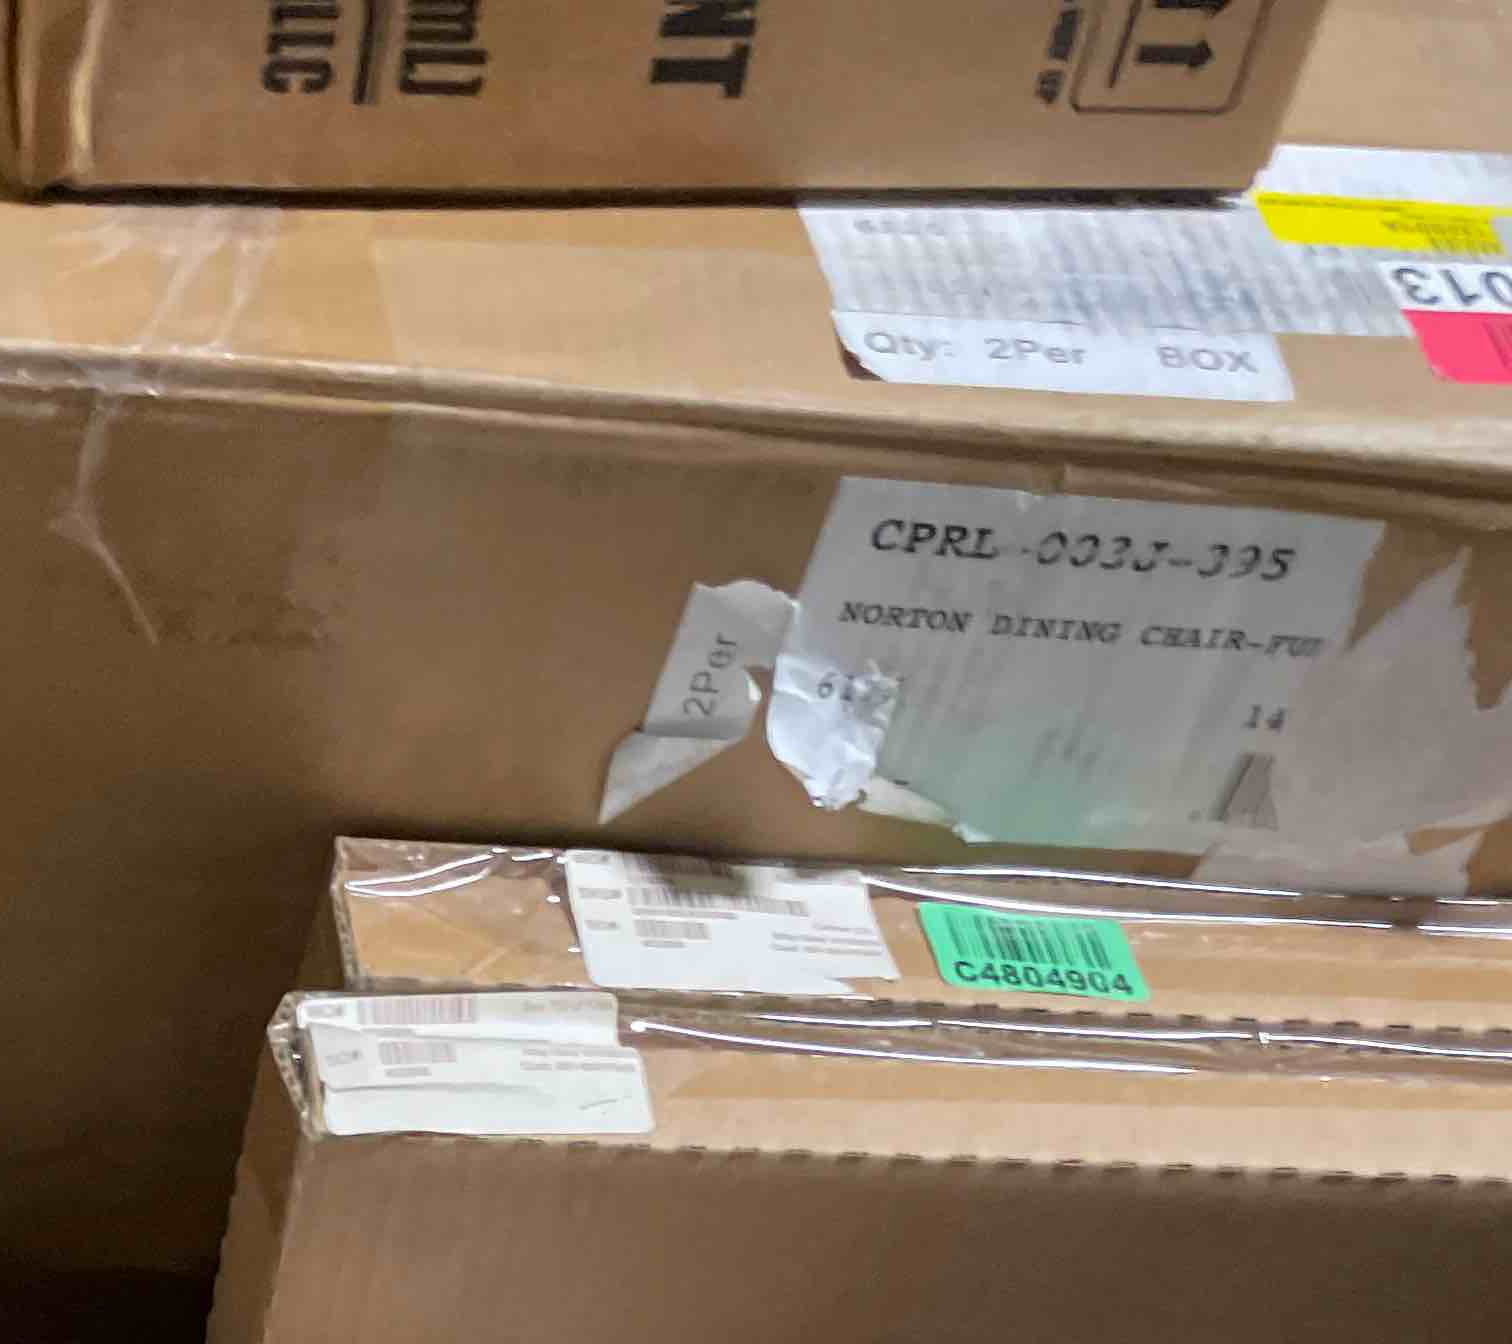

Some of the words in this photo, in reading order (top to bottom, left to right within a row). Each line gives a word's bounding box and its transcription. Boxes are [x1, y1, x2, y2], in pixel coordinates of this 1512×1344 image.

[984, 336, 1087, 366] 2Per
[839, 601, 973, 632] NORTON
[990, 613, 1121, 644] DINING
[953, 960, 1135, 995] C4804904
